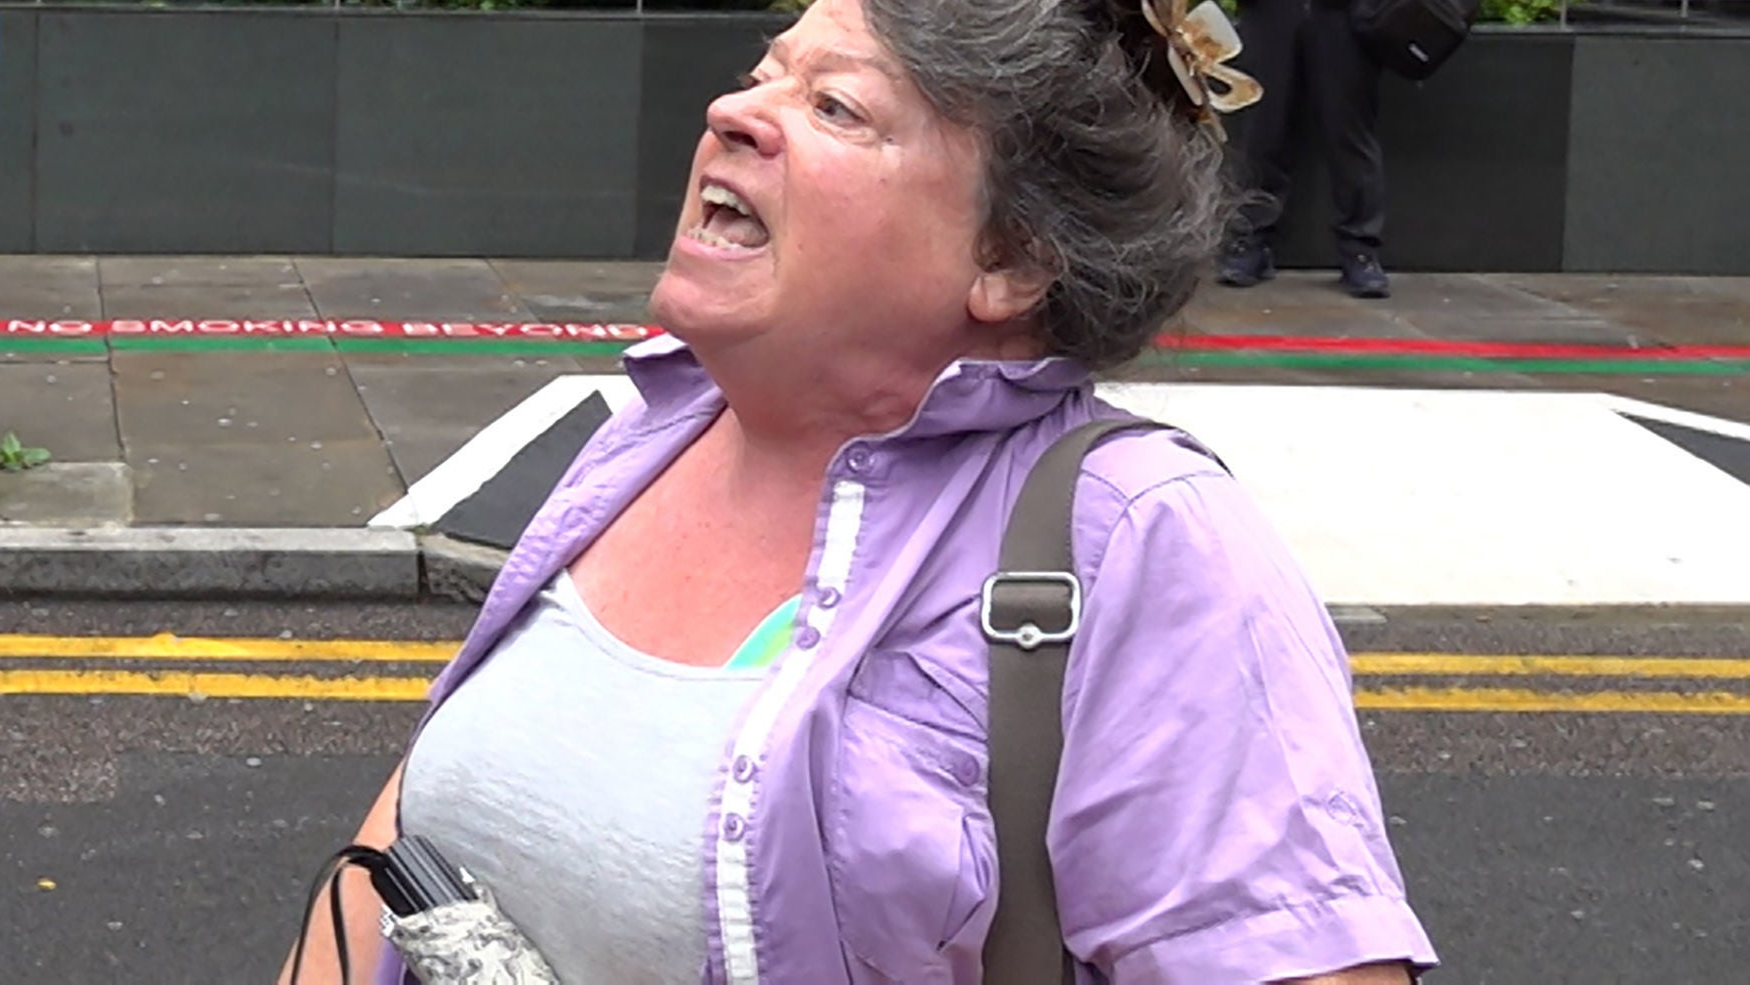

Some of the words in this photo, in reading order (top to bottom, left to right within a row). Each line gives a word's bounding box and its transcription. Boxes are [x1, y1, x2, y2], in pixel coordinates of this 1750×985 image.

[8, 319, 91, 333] NO
[111, 319, 383, 334] SMOKING
[402, 322, 648, 337] BEYOND
